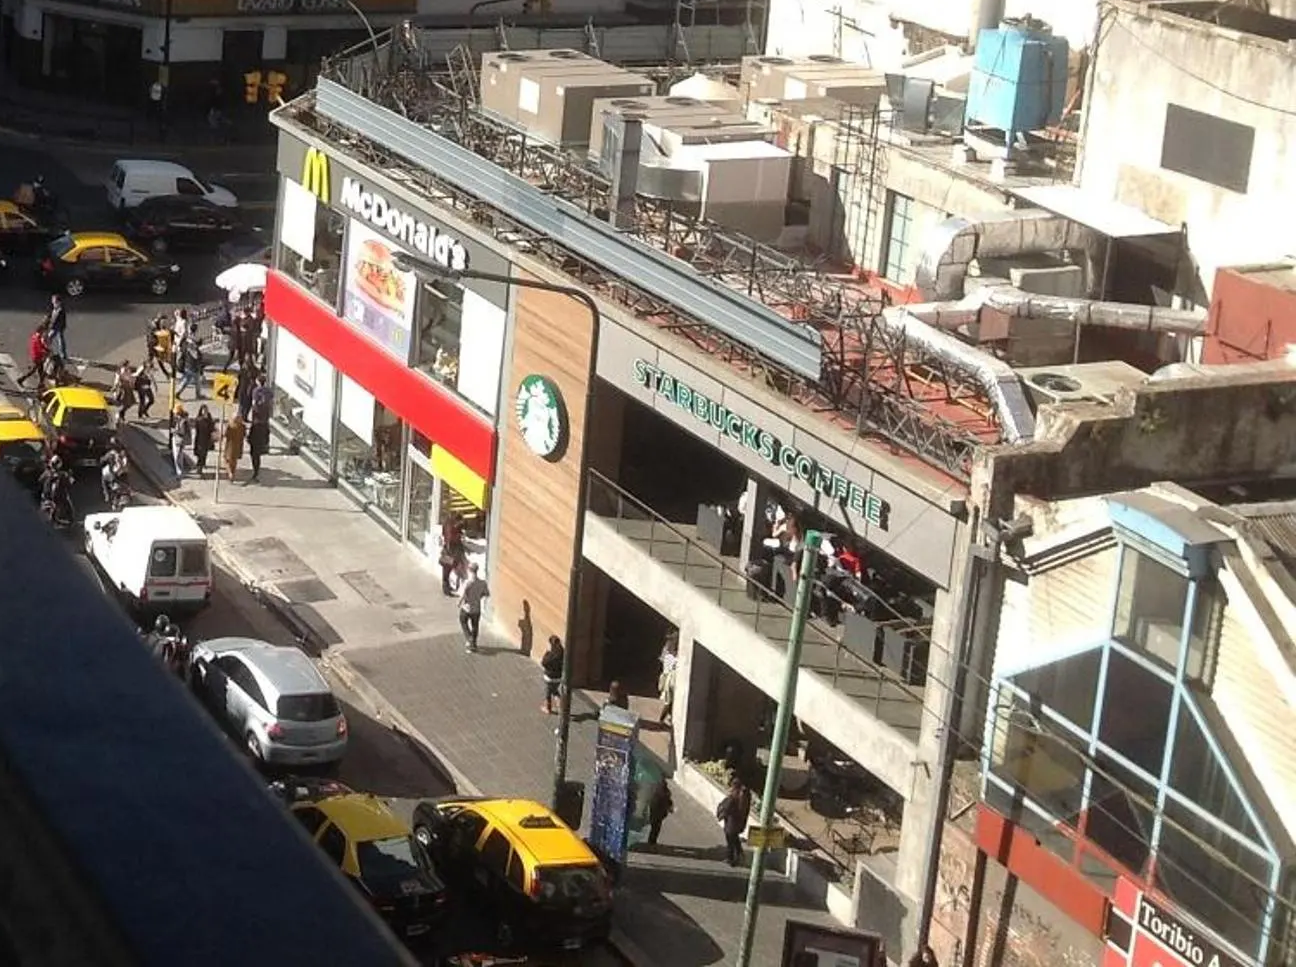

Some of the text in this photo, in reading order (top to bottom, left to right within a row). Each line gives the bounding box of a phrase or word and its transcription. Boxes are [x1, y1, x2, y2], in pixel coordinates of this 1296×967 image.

[340, 177, 467, 271] McDonald's
[633, 358, 883, 528] STARBUCKS COFFEE
[1141, 902, 1203, 964] Toribio
